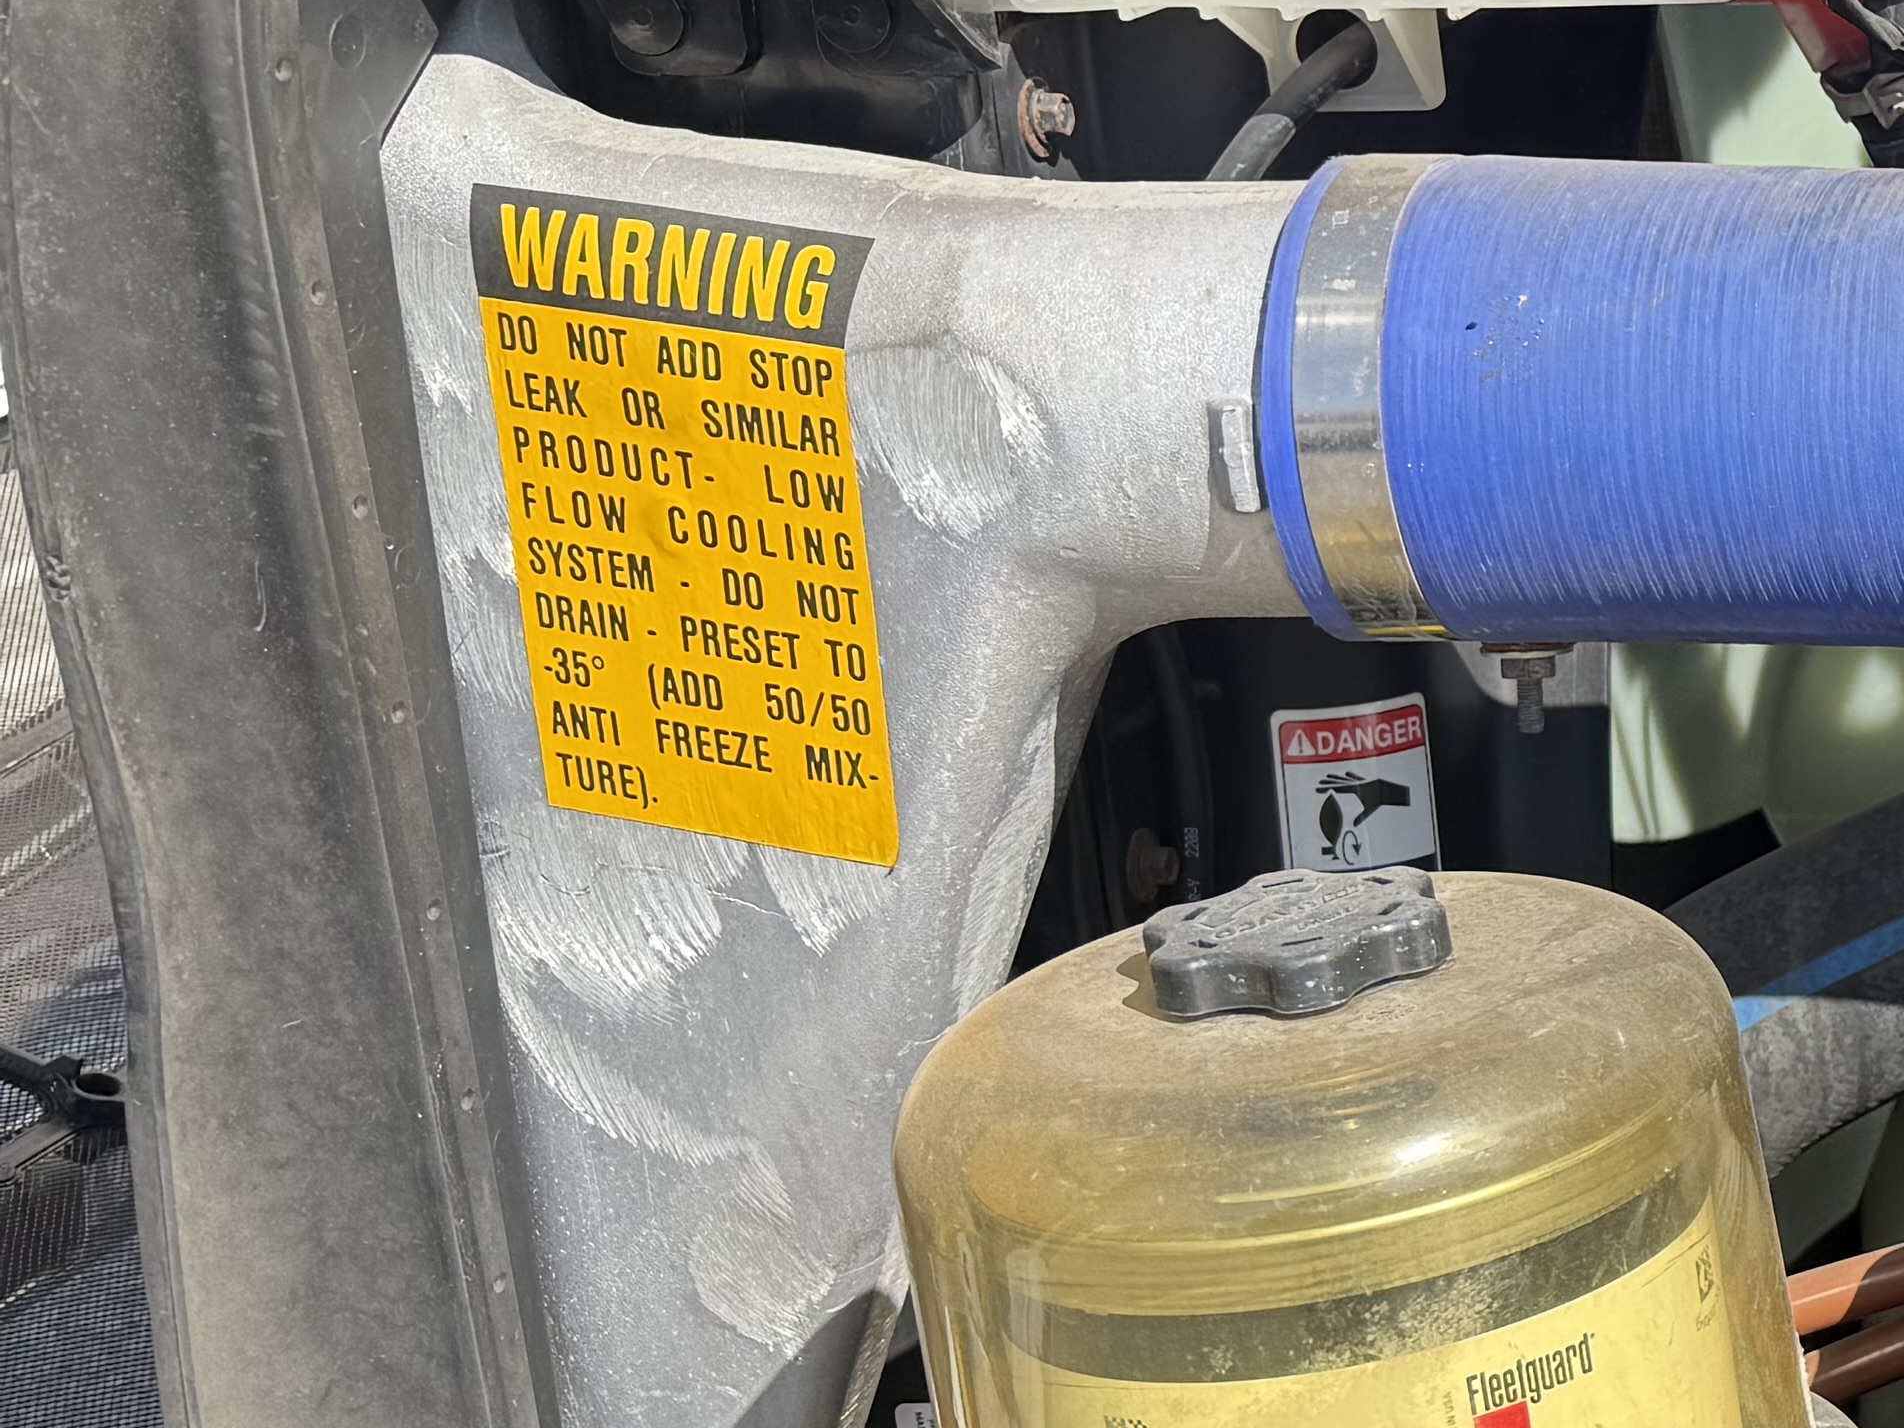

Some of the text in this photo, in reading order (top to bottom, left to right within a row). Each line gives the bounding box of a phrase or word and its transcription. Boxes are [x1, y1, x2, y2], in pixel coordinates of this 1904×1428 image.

[498, 204, 837, 331] WARNING
[497, 313, 833, 398] DO NOT ADD STOP
[503, 367, 841, 457] LEAK OR SIMILAR
[522, 483, 856, 571] FLOW COOLING
[765, 464, 846, 514] LOW
[528, 536, 861, 626] SYSTEM DO NOT
[536, 592, 867, 682] DRAIN PRESET TO
[543, 647, 872, 736] -35° (ADD 50/50
[1317, 716, 1422, 755] DANGER
[551, 702, 880, 790] ANTI FREEZE MIX-
[555, 753, 659, 808] TURE).
[1441, 1390, 1454, 1415] USA
[1466, 1333, 1594, 1418] Fleetguard
